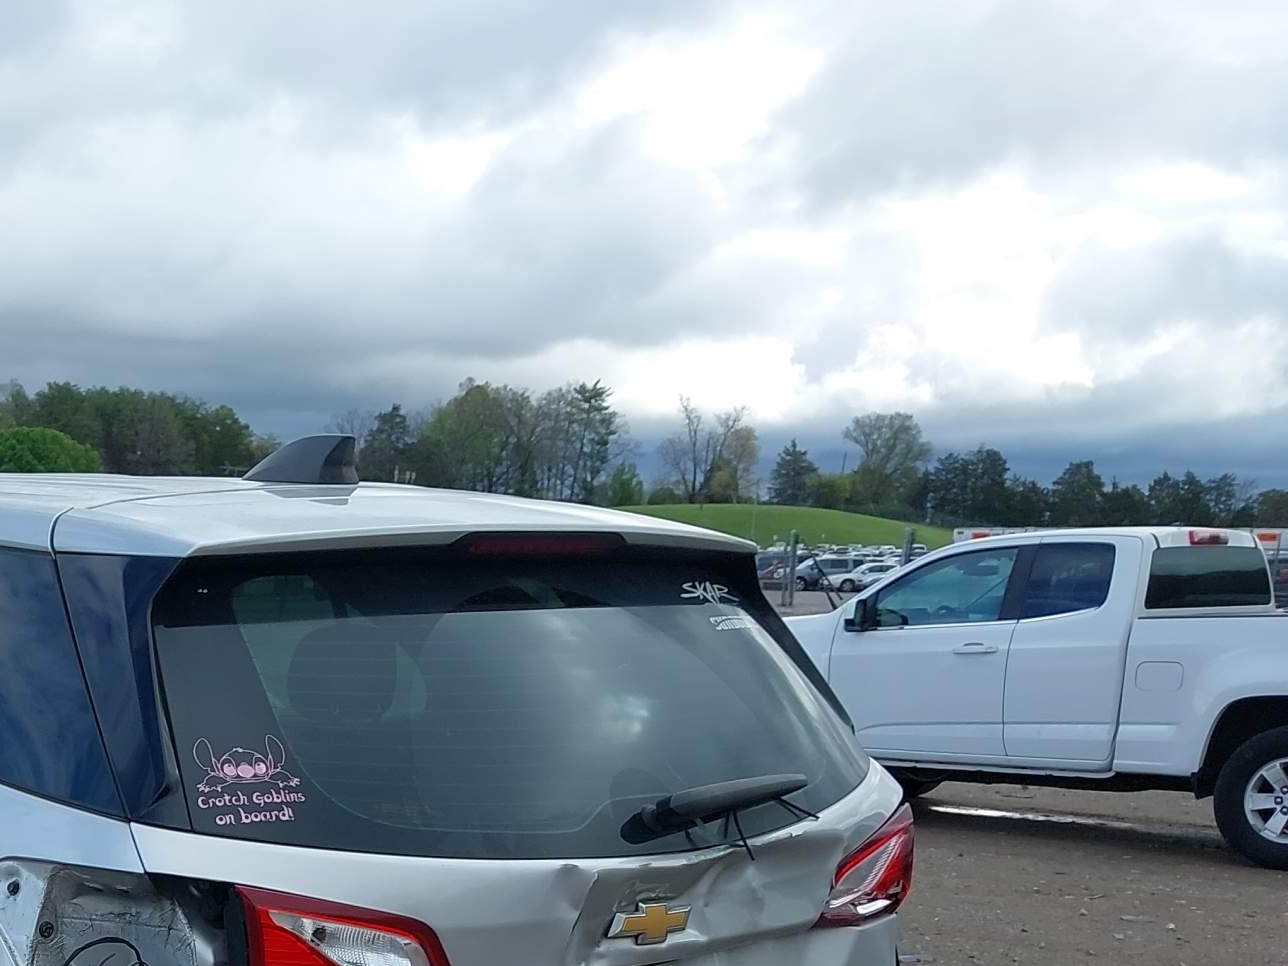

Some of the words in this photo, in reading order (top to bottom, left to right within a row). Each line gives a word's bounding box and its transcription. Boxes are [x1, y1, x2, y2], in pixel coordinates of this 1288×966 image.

[680, 581, 740, 605] SKAR
[197, 790, 249, 809] Crotch
[252, 788, 306, 807] Goblins
[215, 814, 237, 825] on
[238, 804, 295, 824] board!
